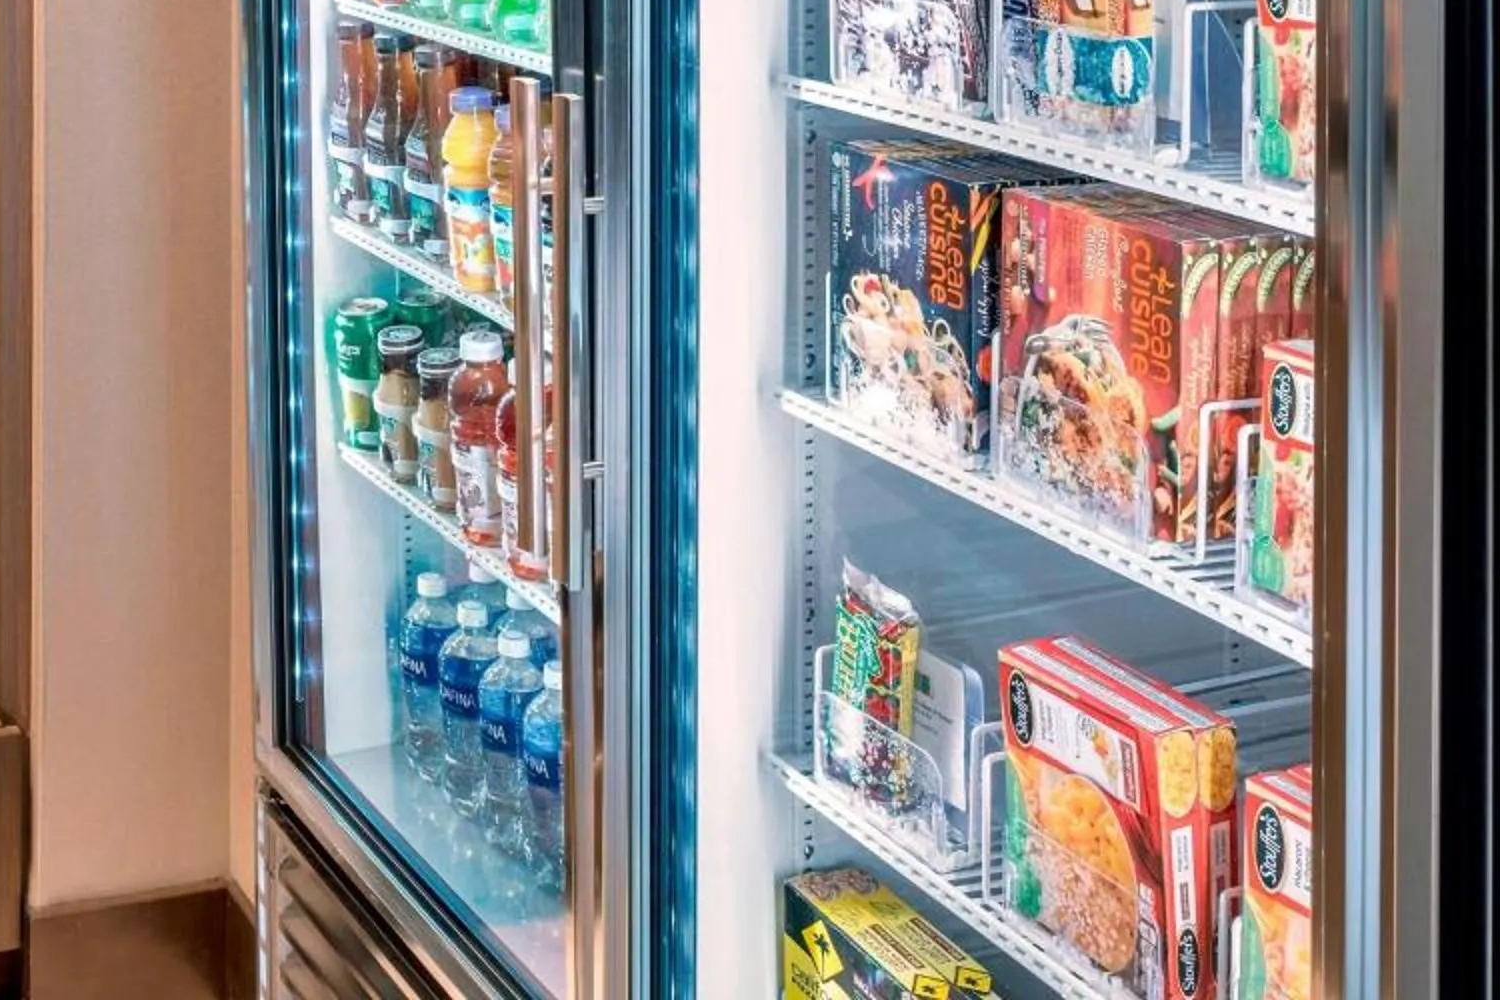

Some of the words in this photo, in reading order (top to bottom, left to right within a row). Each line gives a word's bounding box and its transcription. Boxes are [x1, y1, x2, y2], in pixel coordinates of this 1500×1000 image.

[1271, 372, 1293, 432] Stouffer's
[1011, 676, 1030, 742] Stouffer's
[1259, 812, 1280, 887] Stouffer's
[1181, 930, 1196, 991] Stouffer's
